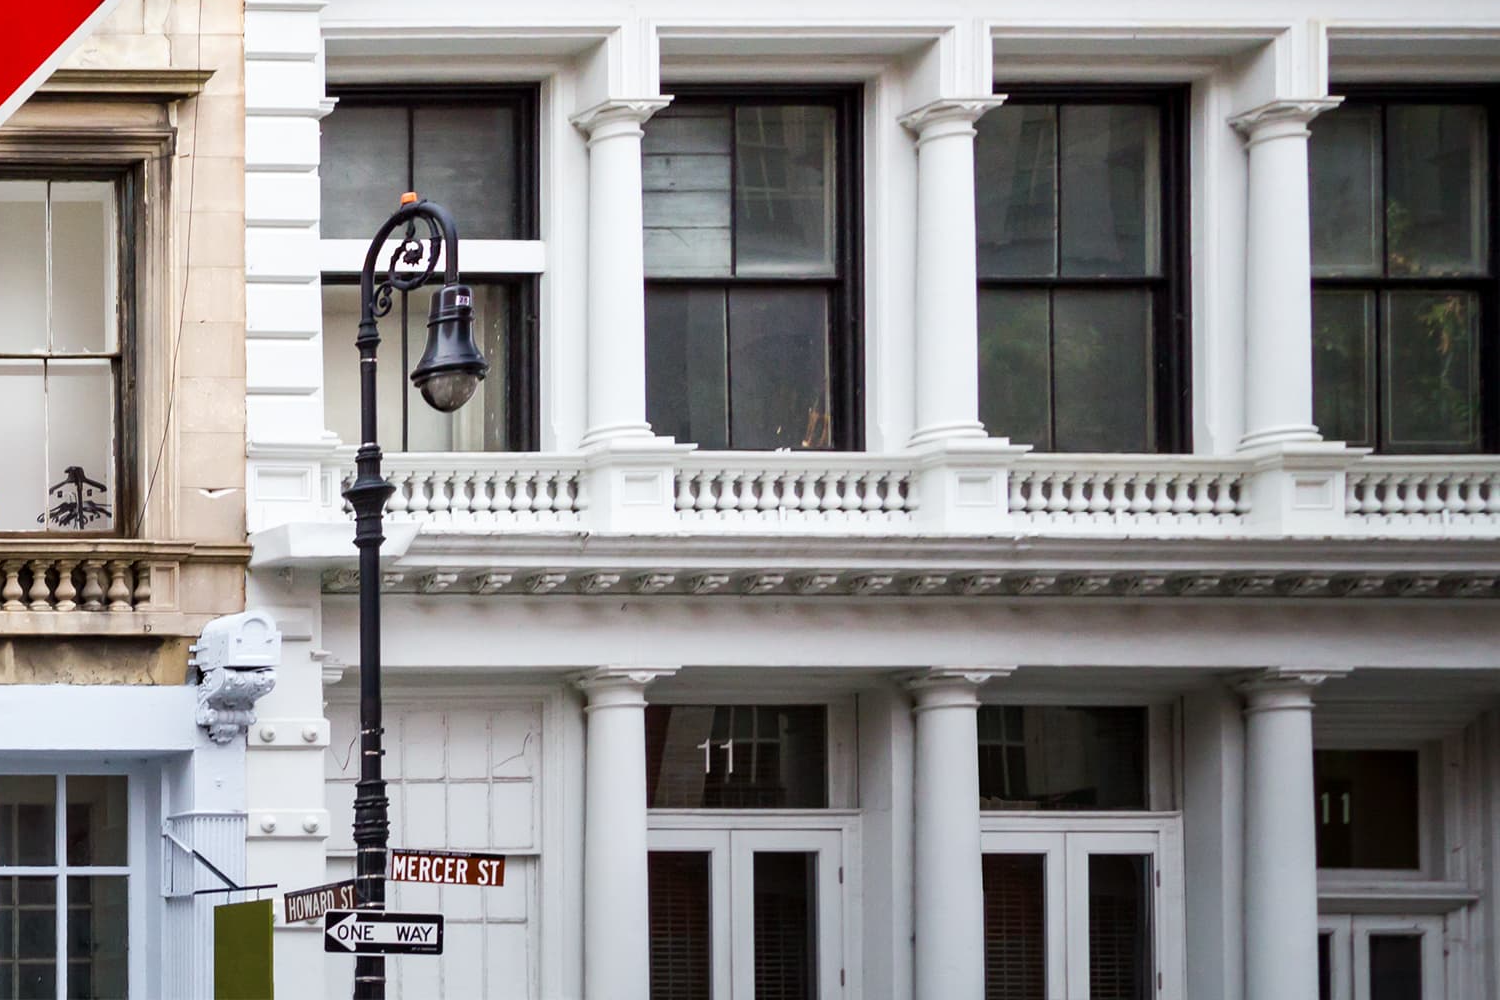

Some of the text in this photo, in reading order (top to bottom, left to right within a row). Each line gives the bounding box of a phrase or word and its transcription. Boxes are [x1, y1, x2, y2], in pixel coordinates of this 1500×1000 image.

[697, 738, 733, 774] 11
[392, 855, 501, 886] MERCER ST
[288, 889, 335, 921] HOWARD
[340, 884, 354, 909] ST
[337, 924, 434, 943] ONE WAY
